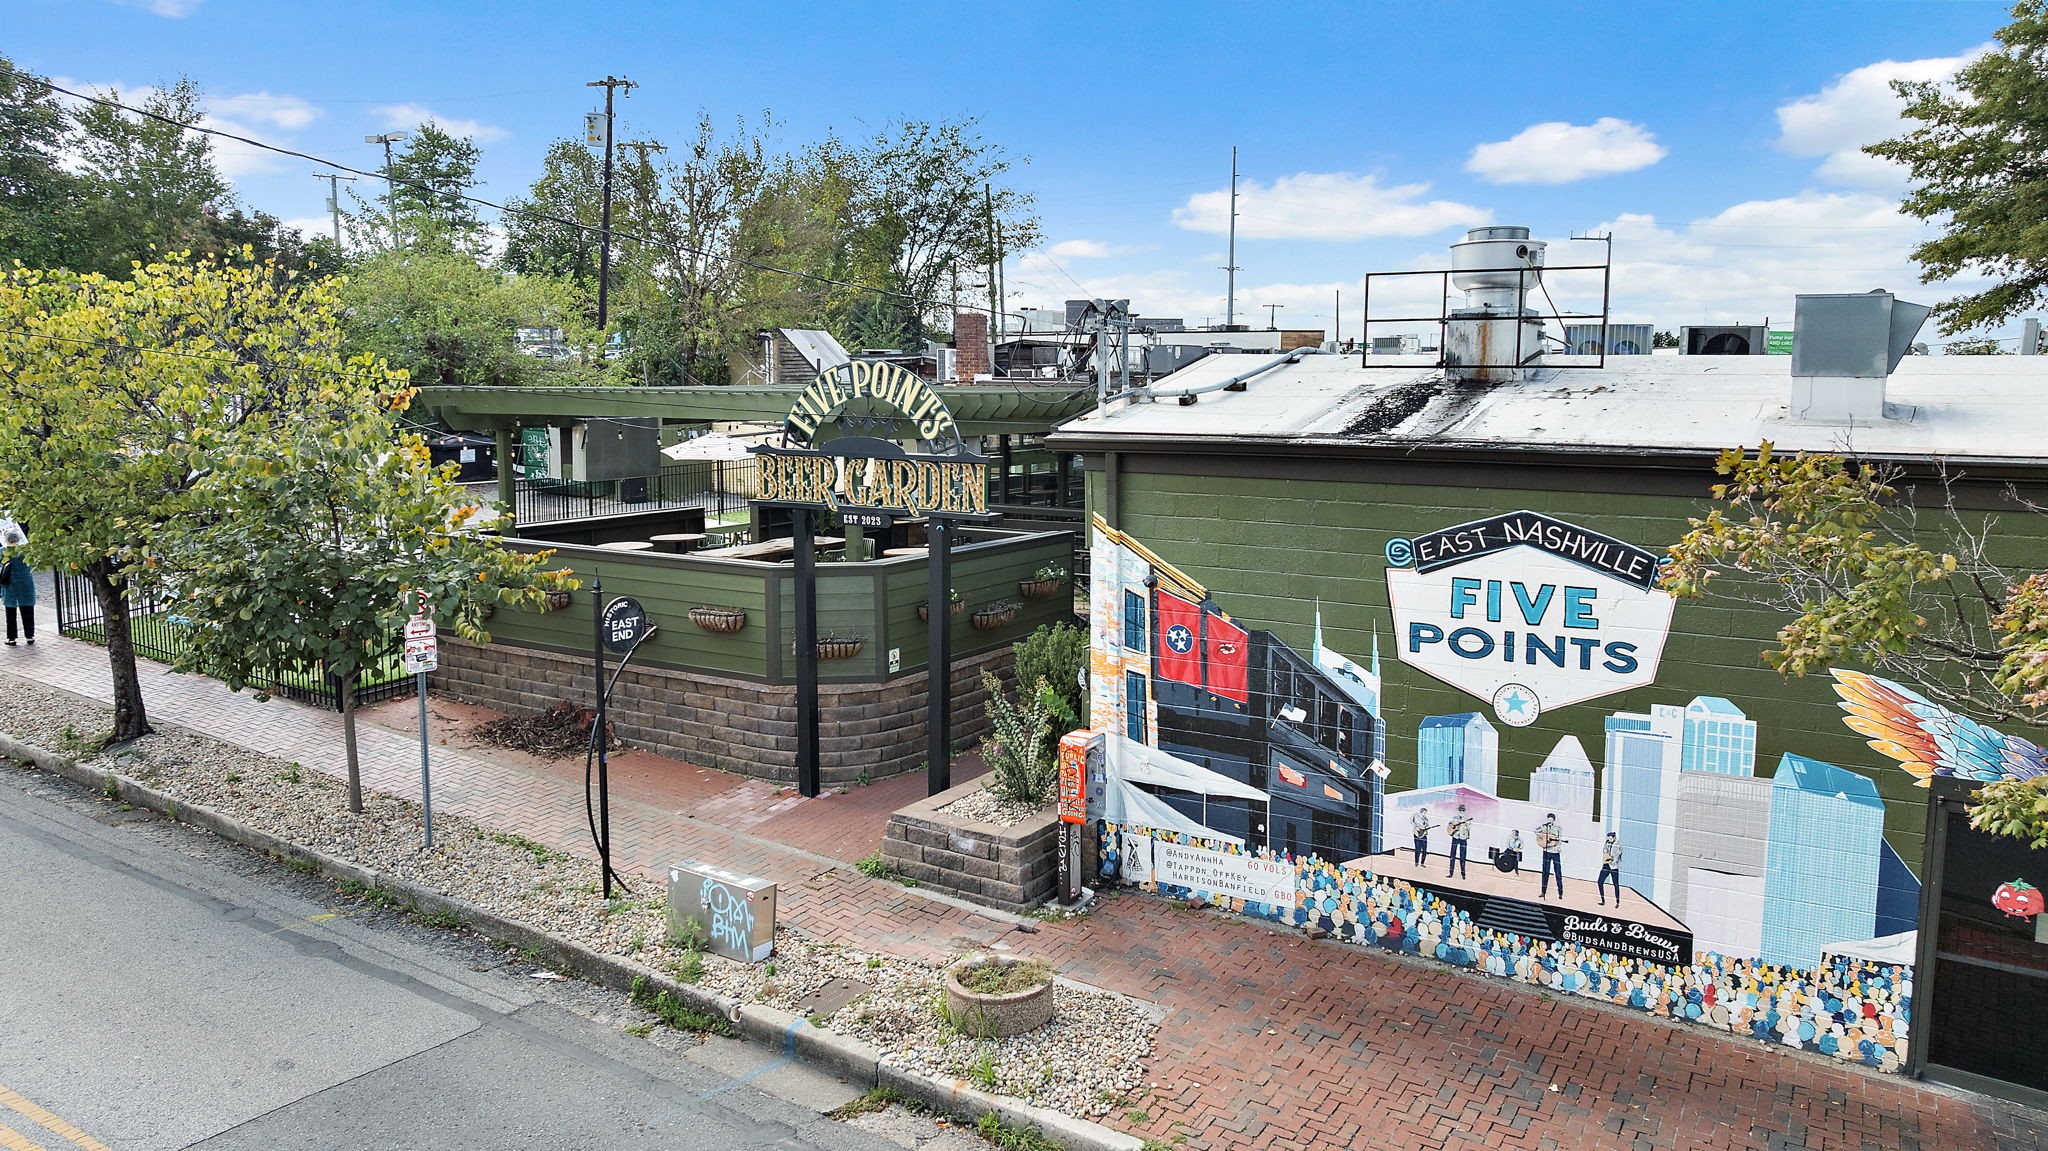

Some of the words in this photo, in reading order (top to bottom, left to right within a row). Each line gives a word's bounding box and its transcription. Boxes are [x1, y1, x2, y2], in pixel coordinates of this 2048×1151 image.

[788, 365, 847, 437] FIVE
[851, 360, 953, 440] POINTS
[755, 454, 838, 511] BEER
[844, 458, 988, 517] GARDEN
[843, 514, 859, 525] EST
[861, 515, 881, 526] 2023
[1420, 526, 1486, 561] EAST
[1503, 518, 1649, 580] NASHVILLE
[604, 600, 629, 627] HISTORIC
[1450, 576, 1600, 630] FIVE
[611, 616, 640, 631] EAST
[612, 629, 634, 642] END
[1409, 621, 1639, 674] POINTS
[1247, 861, 1259, 871] GO
[1263, 863, 1287, 875] VOLS
[1563, 915, 1608, 933] Buds
[1611, 922, 1623, 934] &
[1625, 923, 1680, 953] Brews
